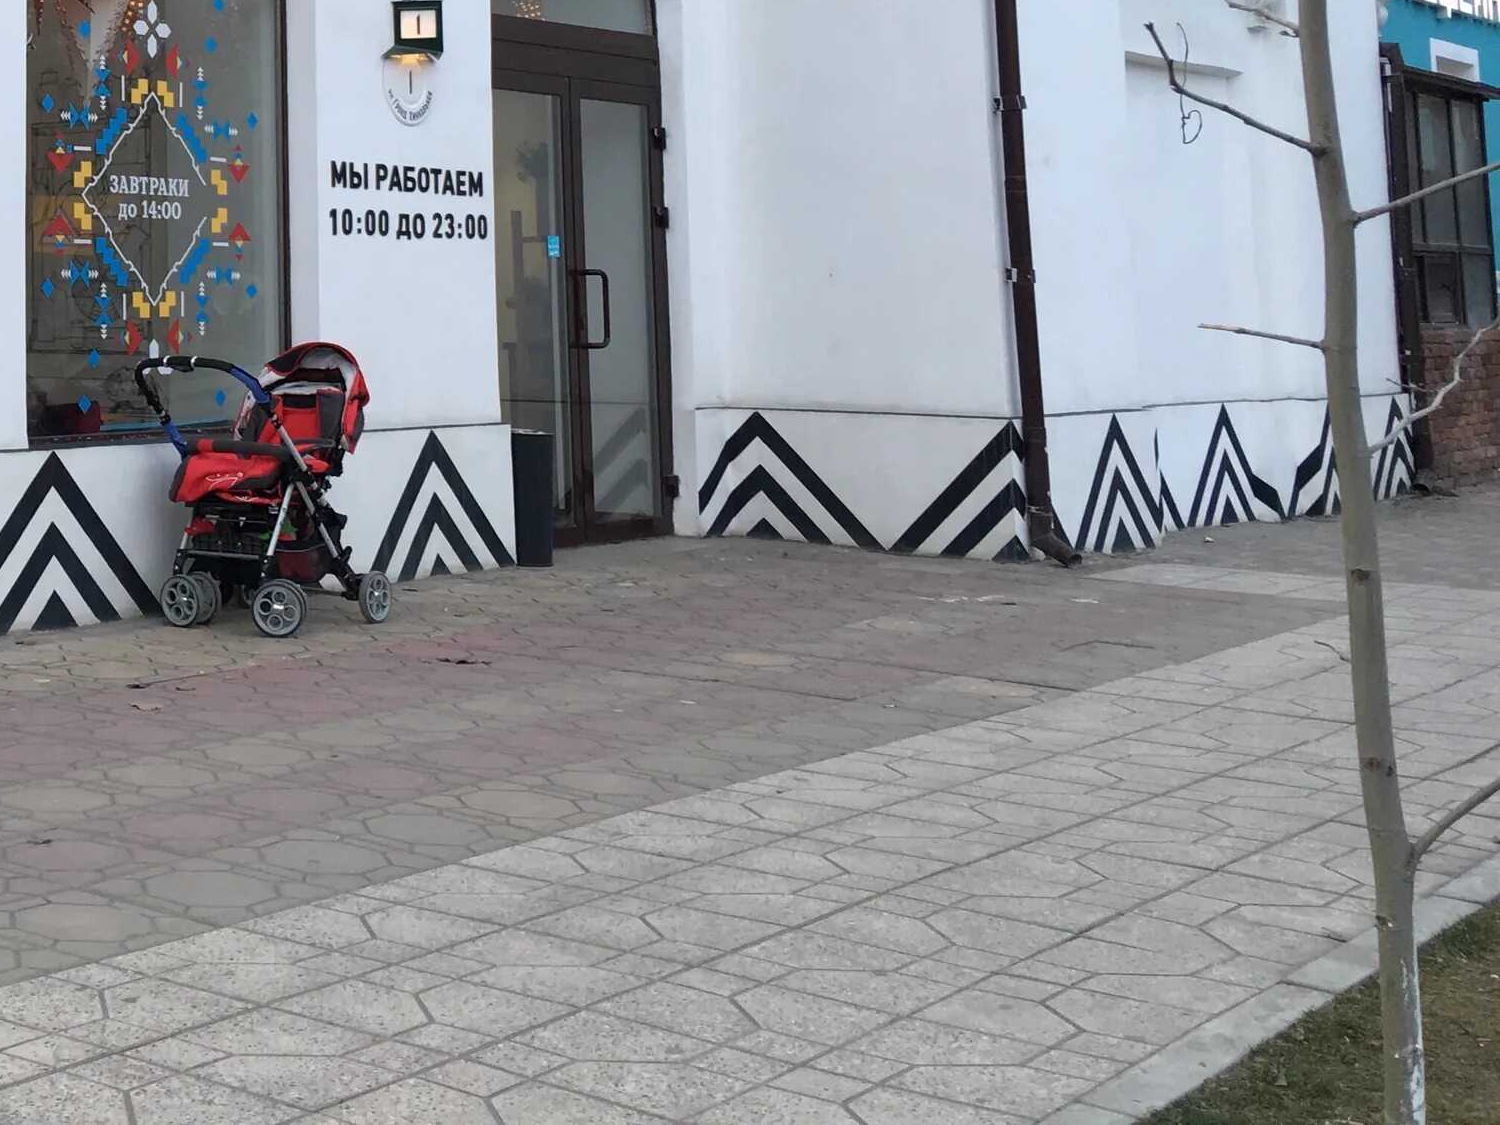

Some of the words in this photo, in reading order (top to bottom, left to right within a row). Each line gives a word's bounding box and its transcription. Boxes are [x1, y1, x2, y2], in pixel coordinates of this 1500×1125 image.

[109, 174, 190, 197] ЗАВТРАКИ
[330, 160, 369, 190] МЫ
[374, 163, 484, 198] РАБОТАЕМ
[141, 199, 182, 220] 14:00
[328, 208, 390, 237] 10:00
[396, 212, 426, 241] ДО
[432, 212, 488, 240] 23:00
